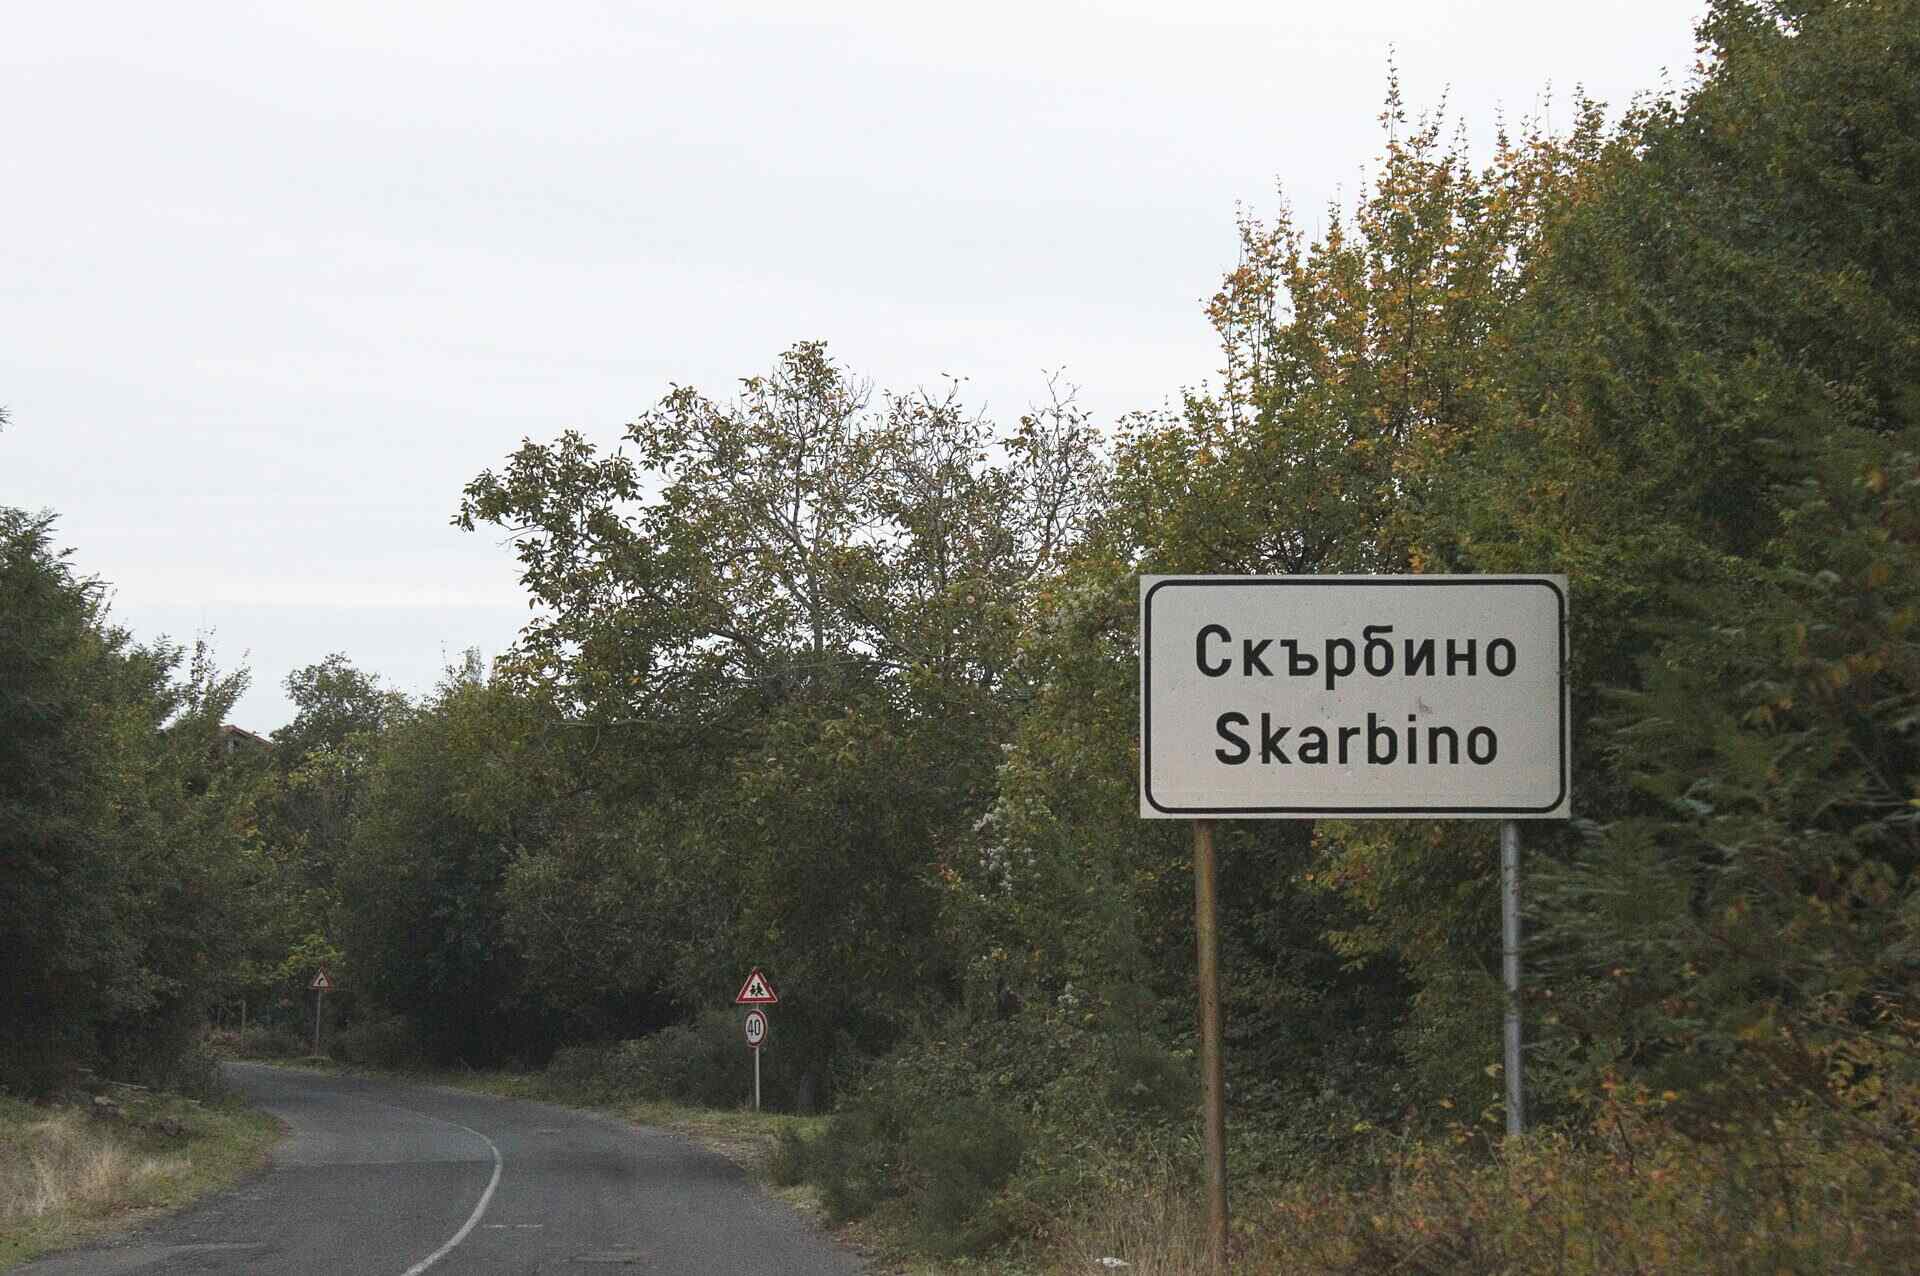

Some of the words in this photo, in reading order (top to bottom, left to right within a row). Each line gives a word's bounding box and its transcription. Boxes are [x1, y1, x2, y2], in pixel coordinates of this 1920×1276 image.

[1196, 624, 1516, 691] Скърбино
[1216, 711, 1497, 766] Skarbino
[747, 1019, 761, 1036] 40
